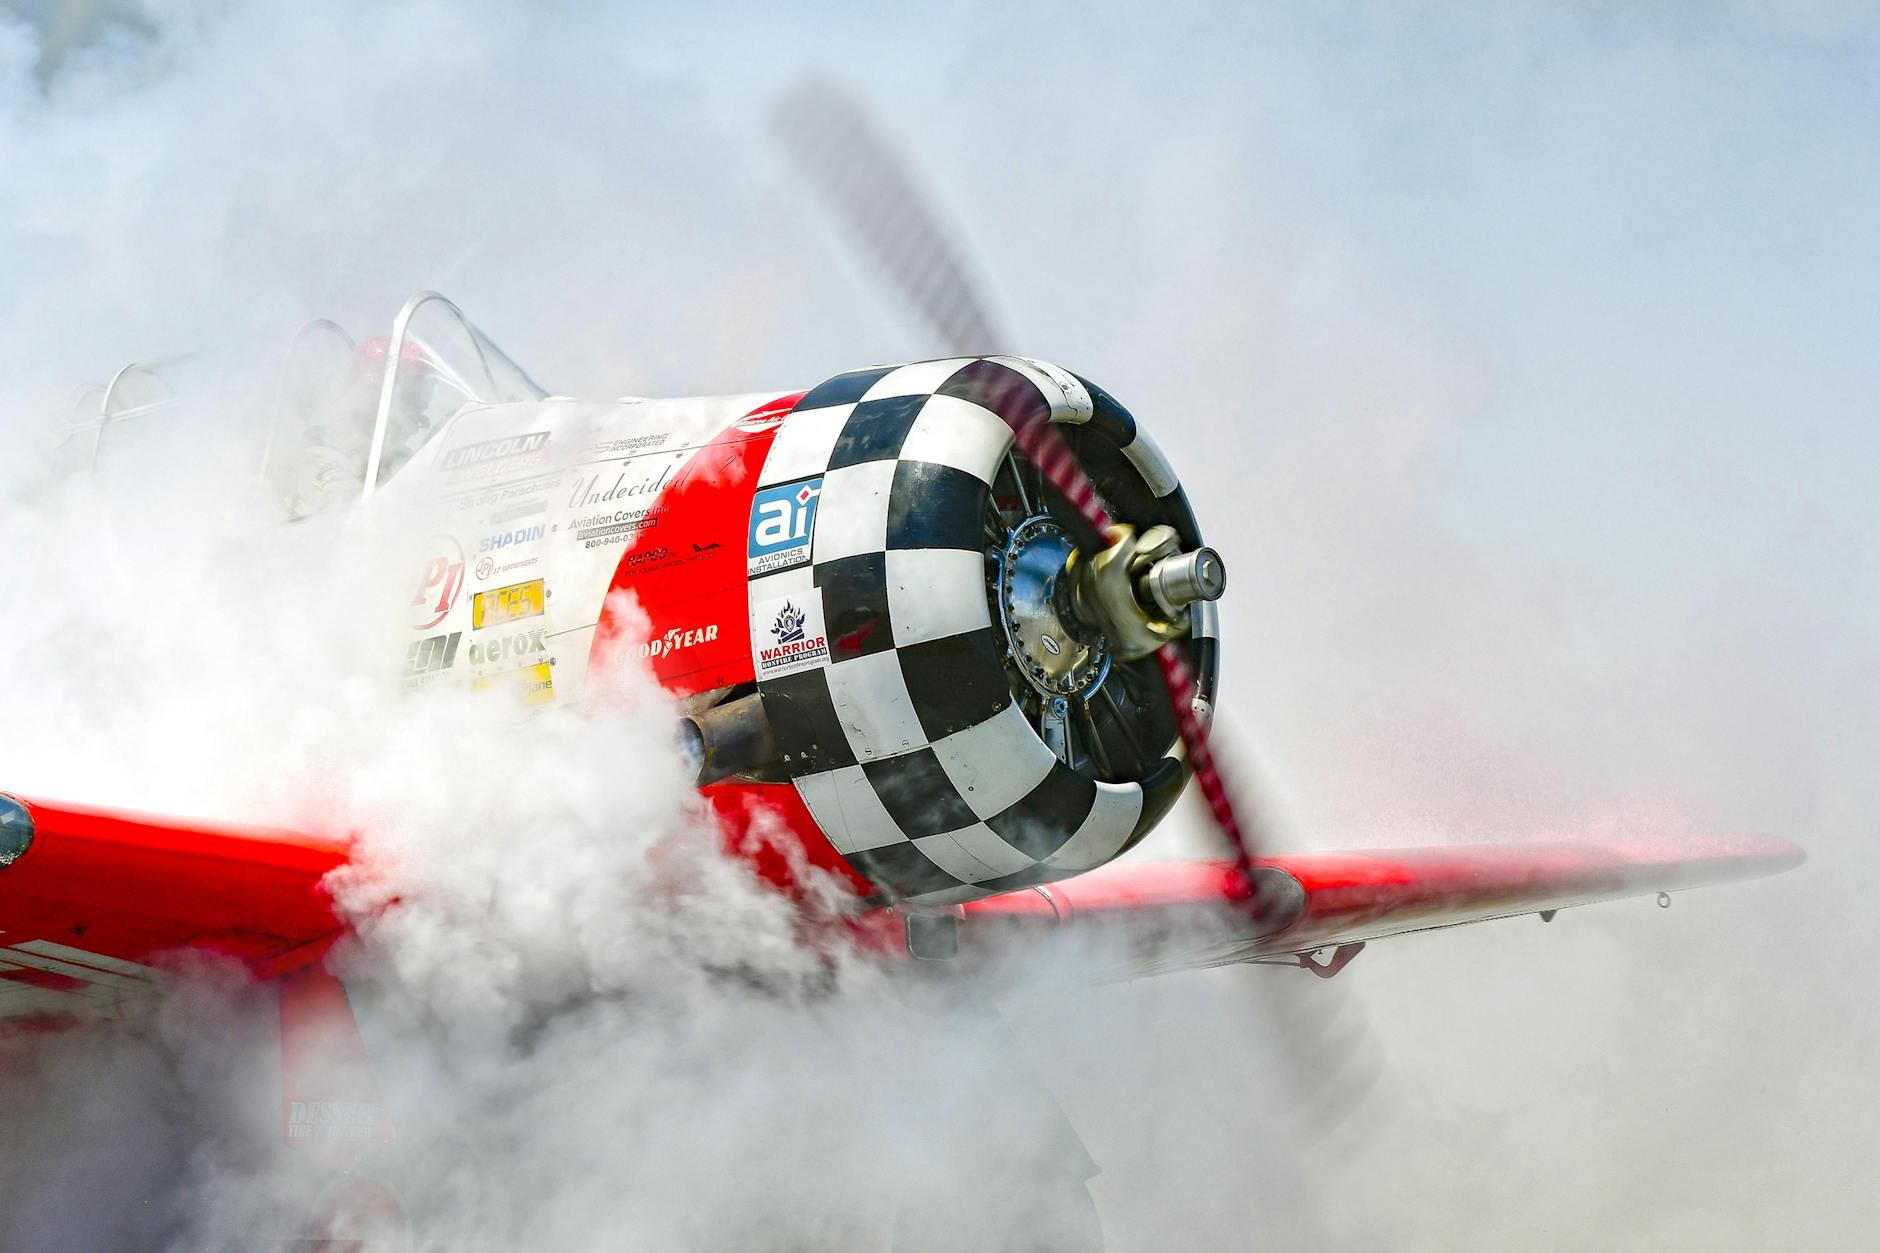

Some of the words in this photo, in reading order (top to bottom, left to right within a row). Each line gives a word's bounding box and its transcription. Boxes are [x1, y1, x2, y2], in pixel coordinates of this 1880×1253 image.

[446, 434, 545, 469] LINCOLN
[609, 440, 665, 452] INCORPORATED
[612, 433, 669, 447] ENGINEERING
[568, 461, 698, 508] Undecided
[569, 513, 611, 529] Aviation
[614, 507, 651, 522] Covers
[755, 485, 818, 546] ai
[479, 524, 546, 553] SHADIN
[578, 518, 657, 538] aviationcovers.com
[585, 530, 645, 549] 800-940-032
[758, 547, 803, 565] AVIONICS
[409, 556, 463, 613] PI
[469, 629, 547, 666] aerox
[636, 624, 718, 660] ODYEAR
[760, 636, 826, 661] WARRIOR
[761, 654, 793, 669] BONFIRE
[794, 647, 827, 664] PROGRAM
[762, 655, 830, 677] www.warriorbonfireprogram.org
